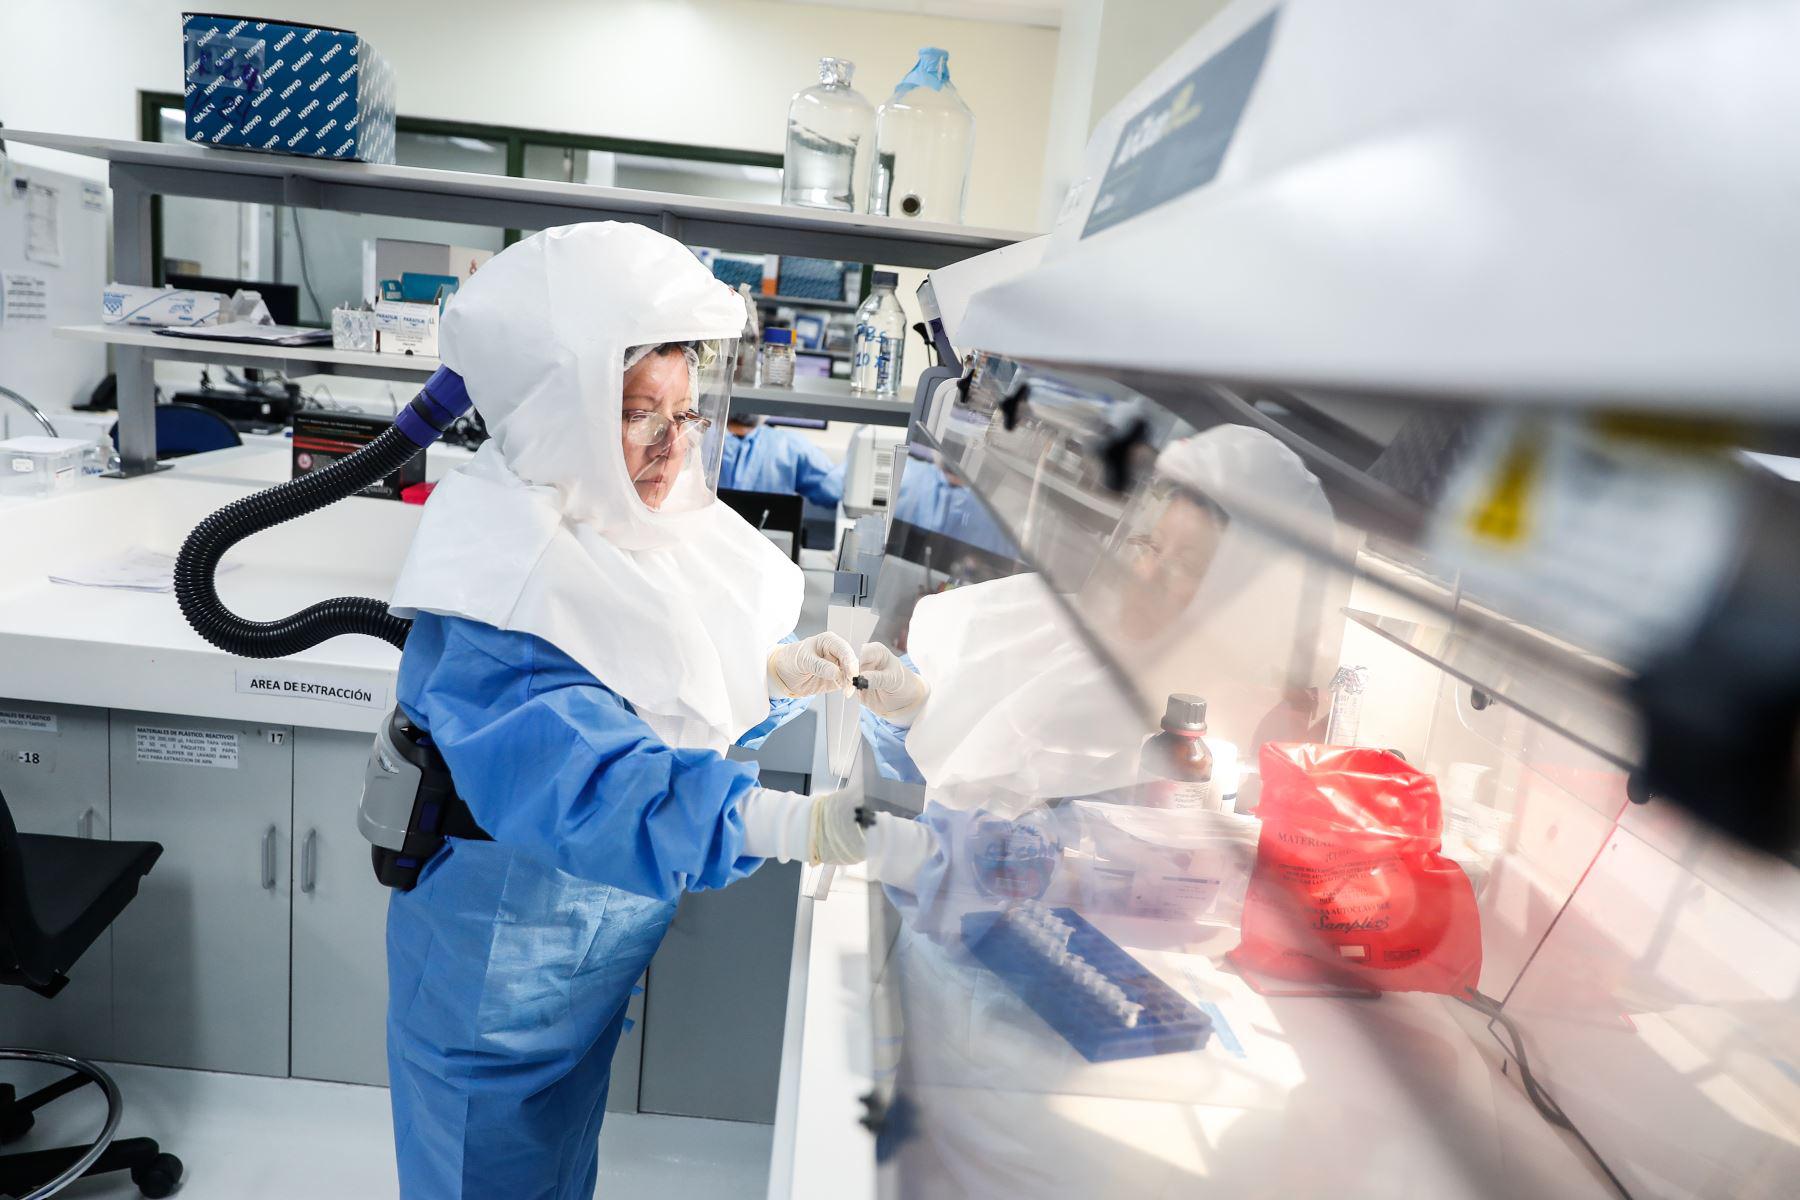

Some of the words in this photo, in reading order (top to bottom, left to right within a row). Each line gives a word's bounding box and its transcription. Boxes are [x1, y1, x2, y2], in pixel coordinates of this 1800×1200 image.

[197, 27, 219, 47] QIAGEN
[274, 31, 295, 51] QIAGEN
[244, 39, 266, 59] QIAGEN
[320, 44, 342, 64] QIAGEN
[263, 59, 284, 79] QIAGEN
[292, 52, 313, 71] QIAGEN
[309, 72, 331, 92] QIAGEN
[338, 64, 359, 84] QIAGEN
[204, 76, 225, 95] QIAGEN
[280, 80, 301, 99] QIAGEN
[252, 87, 273, 107] QIAGEN
[327, 91, 348, 111] QIAGEN
[270, 107, 291, 127] QIAGEN
[298, 100, 319, 119] QIAGEN
[212, 123, 233, 143] QIAGEN
[240, 115, 262, 135] QIAGEN
[316, 119, 337, 139] QIAGEN
[288, 127, 309, 147] QIAGEN
[250, 679, 280, 690] AREA
[284, 682, 300, 692] DE
[301, 682, 372, 702] EXTRACCIÓN
[270, 732, 284, 744] 17
